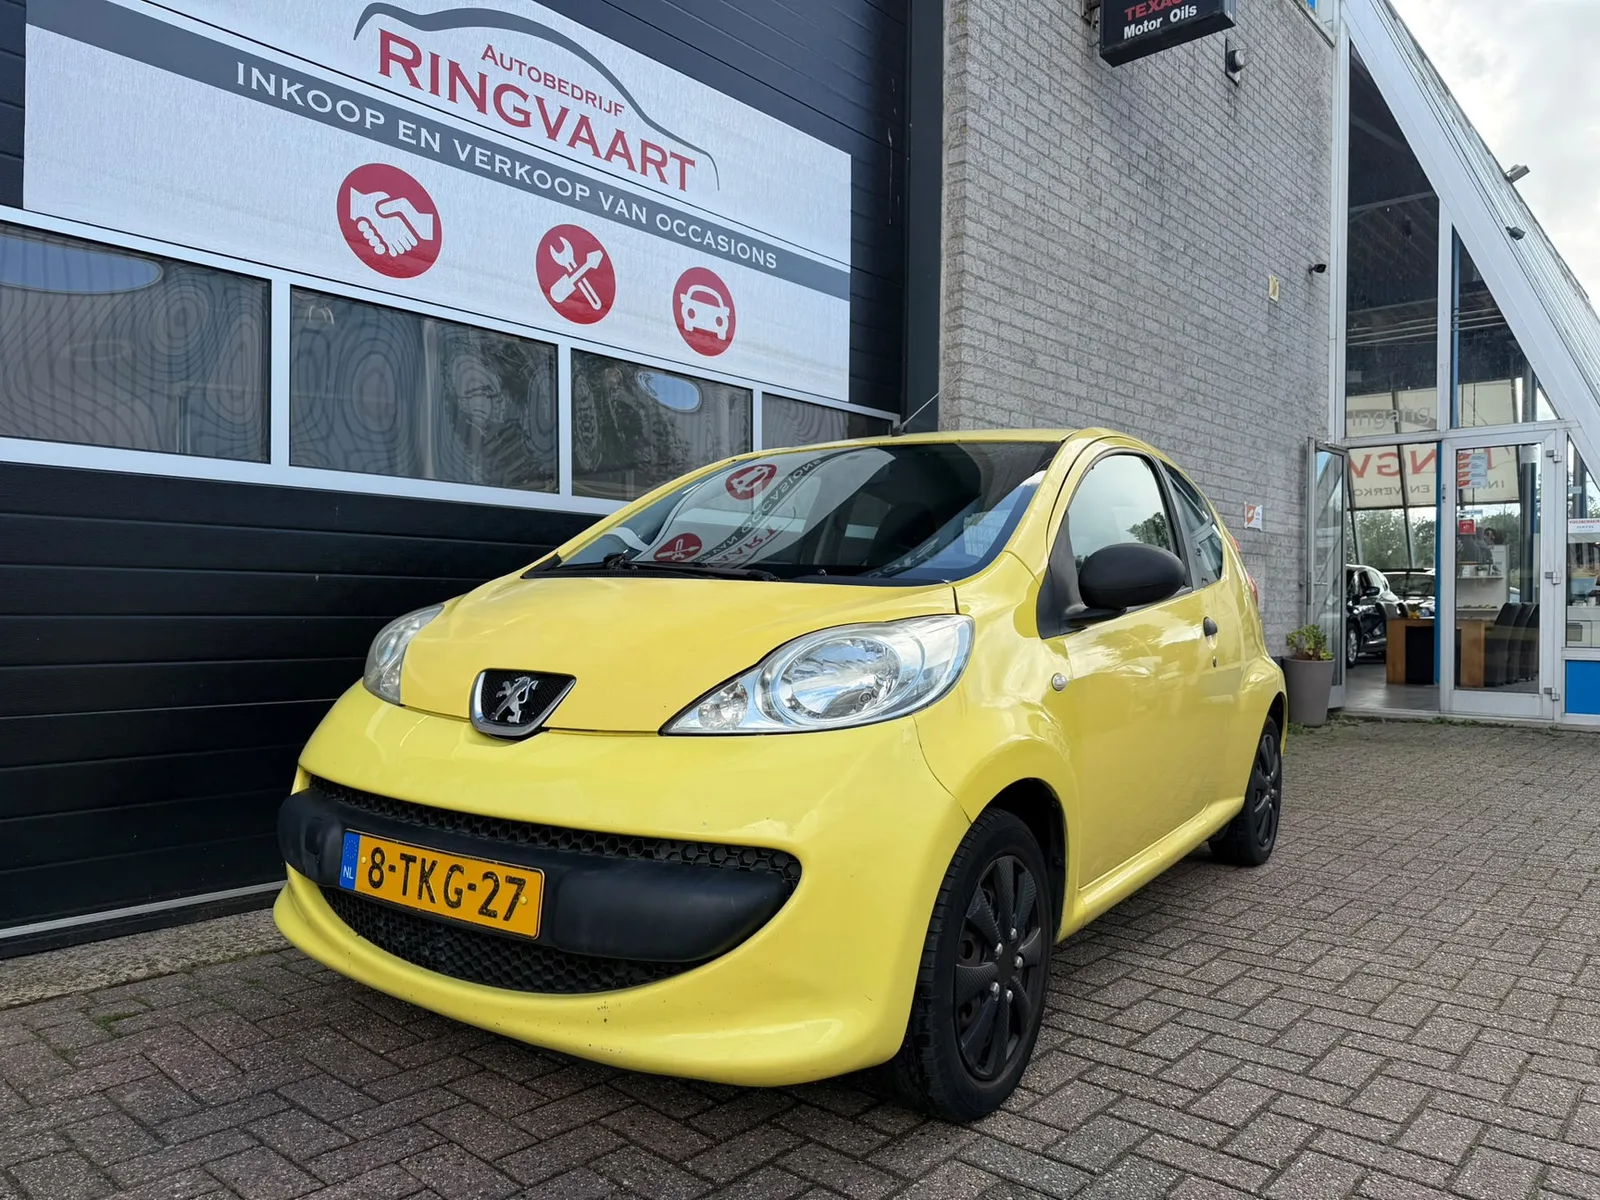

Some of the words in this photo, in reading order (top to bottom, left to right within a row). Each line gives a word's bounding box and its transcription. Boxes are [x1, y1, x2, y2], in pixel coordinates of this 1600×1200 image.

[1123, 17, 1163, 40] Motor
[1169, 4, 1197, 23] Oils
[378, 28, 696, 192] RINGVAART
[481, 44, 625, 118] AUTOBEDRIJF
[236, 62, 385, 130] INKOOP
[398, 124, 441, 153] EN
[452, 142, 591, 203] VERKOOP
[598, 190, 647, 225] VAN
[656, 213, 777, 269] OCCASIONS
[342, 866, 354, 880] NL
[368, 847, 526, 921] 8-TKG-27
